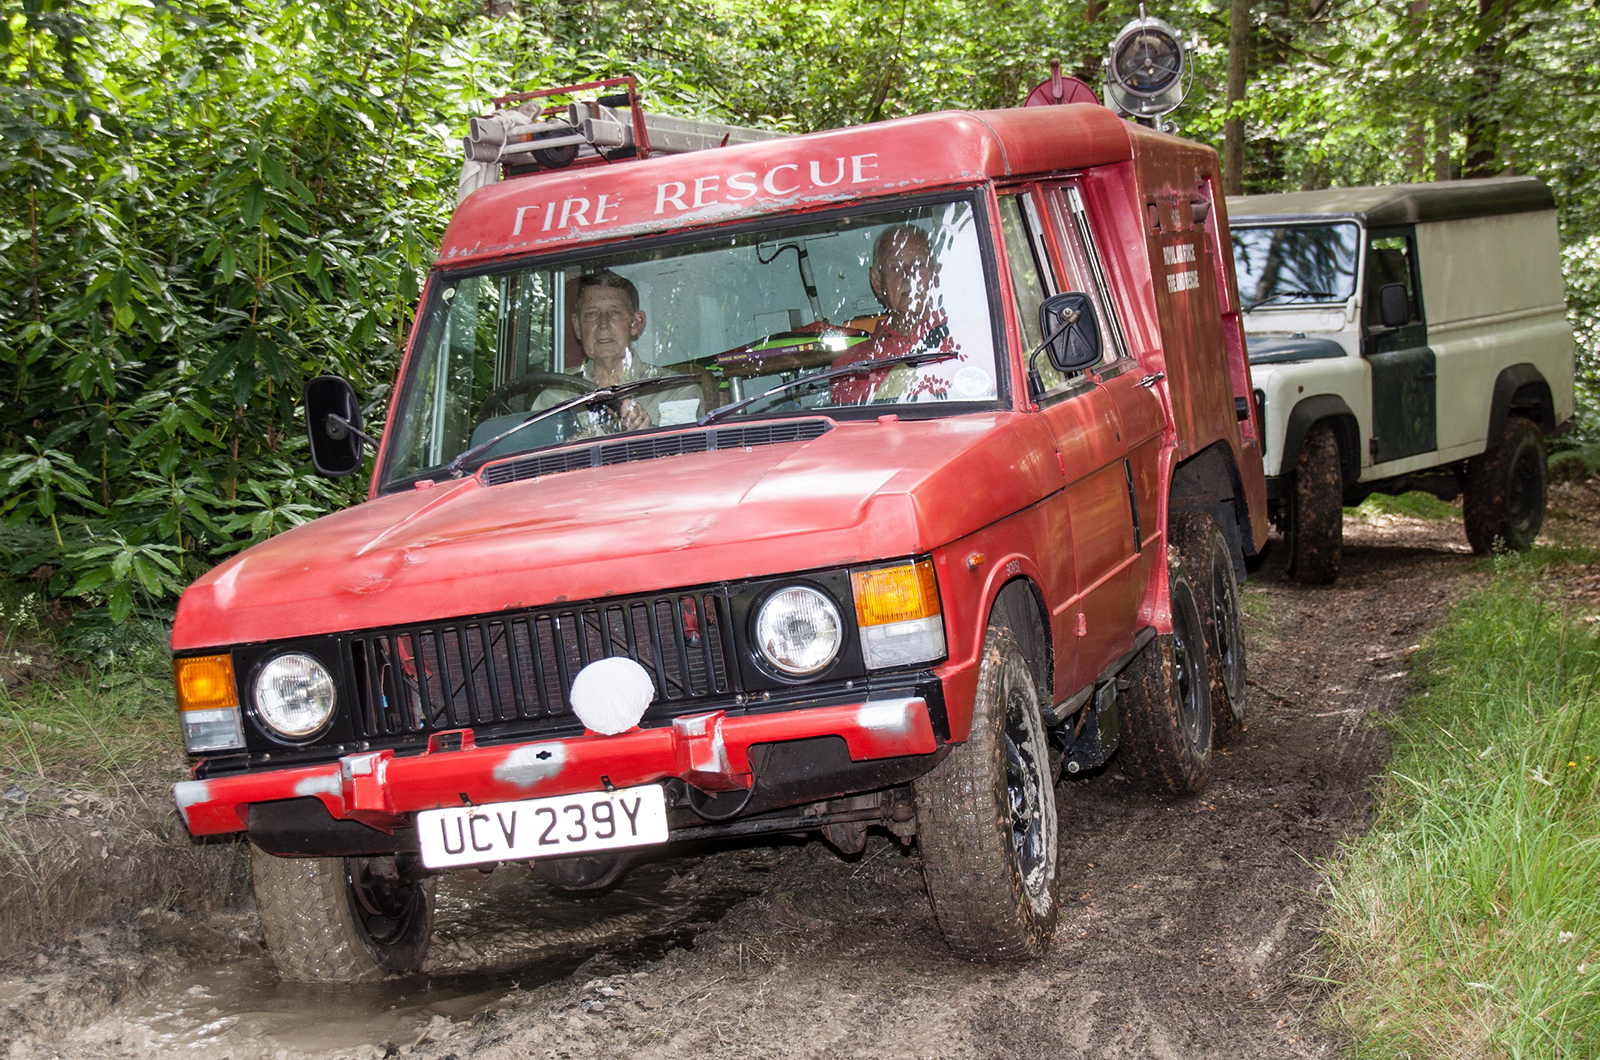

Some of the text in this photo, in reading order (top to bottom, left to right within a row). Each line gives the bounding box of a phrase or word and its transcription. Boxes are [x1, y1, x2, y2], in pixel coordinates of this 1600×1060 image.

[512, 152, 881, 236] FIRE RESCUE
[440, 797, 641, 855] UCV 239Y
